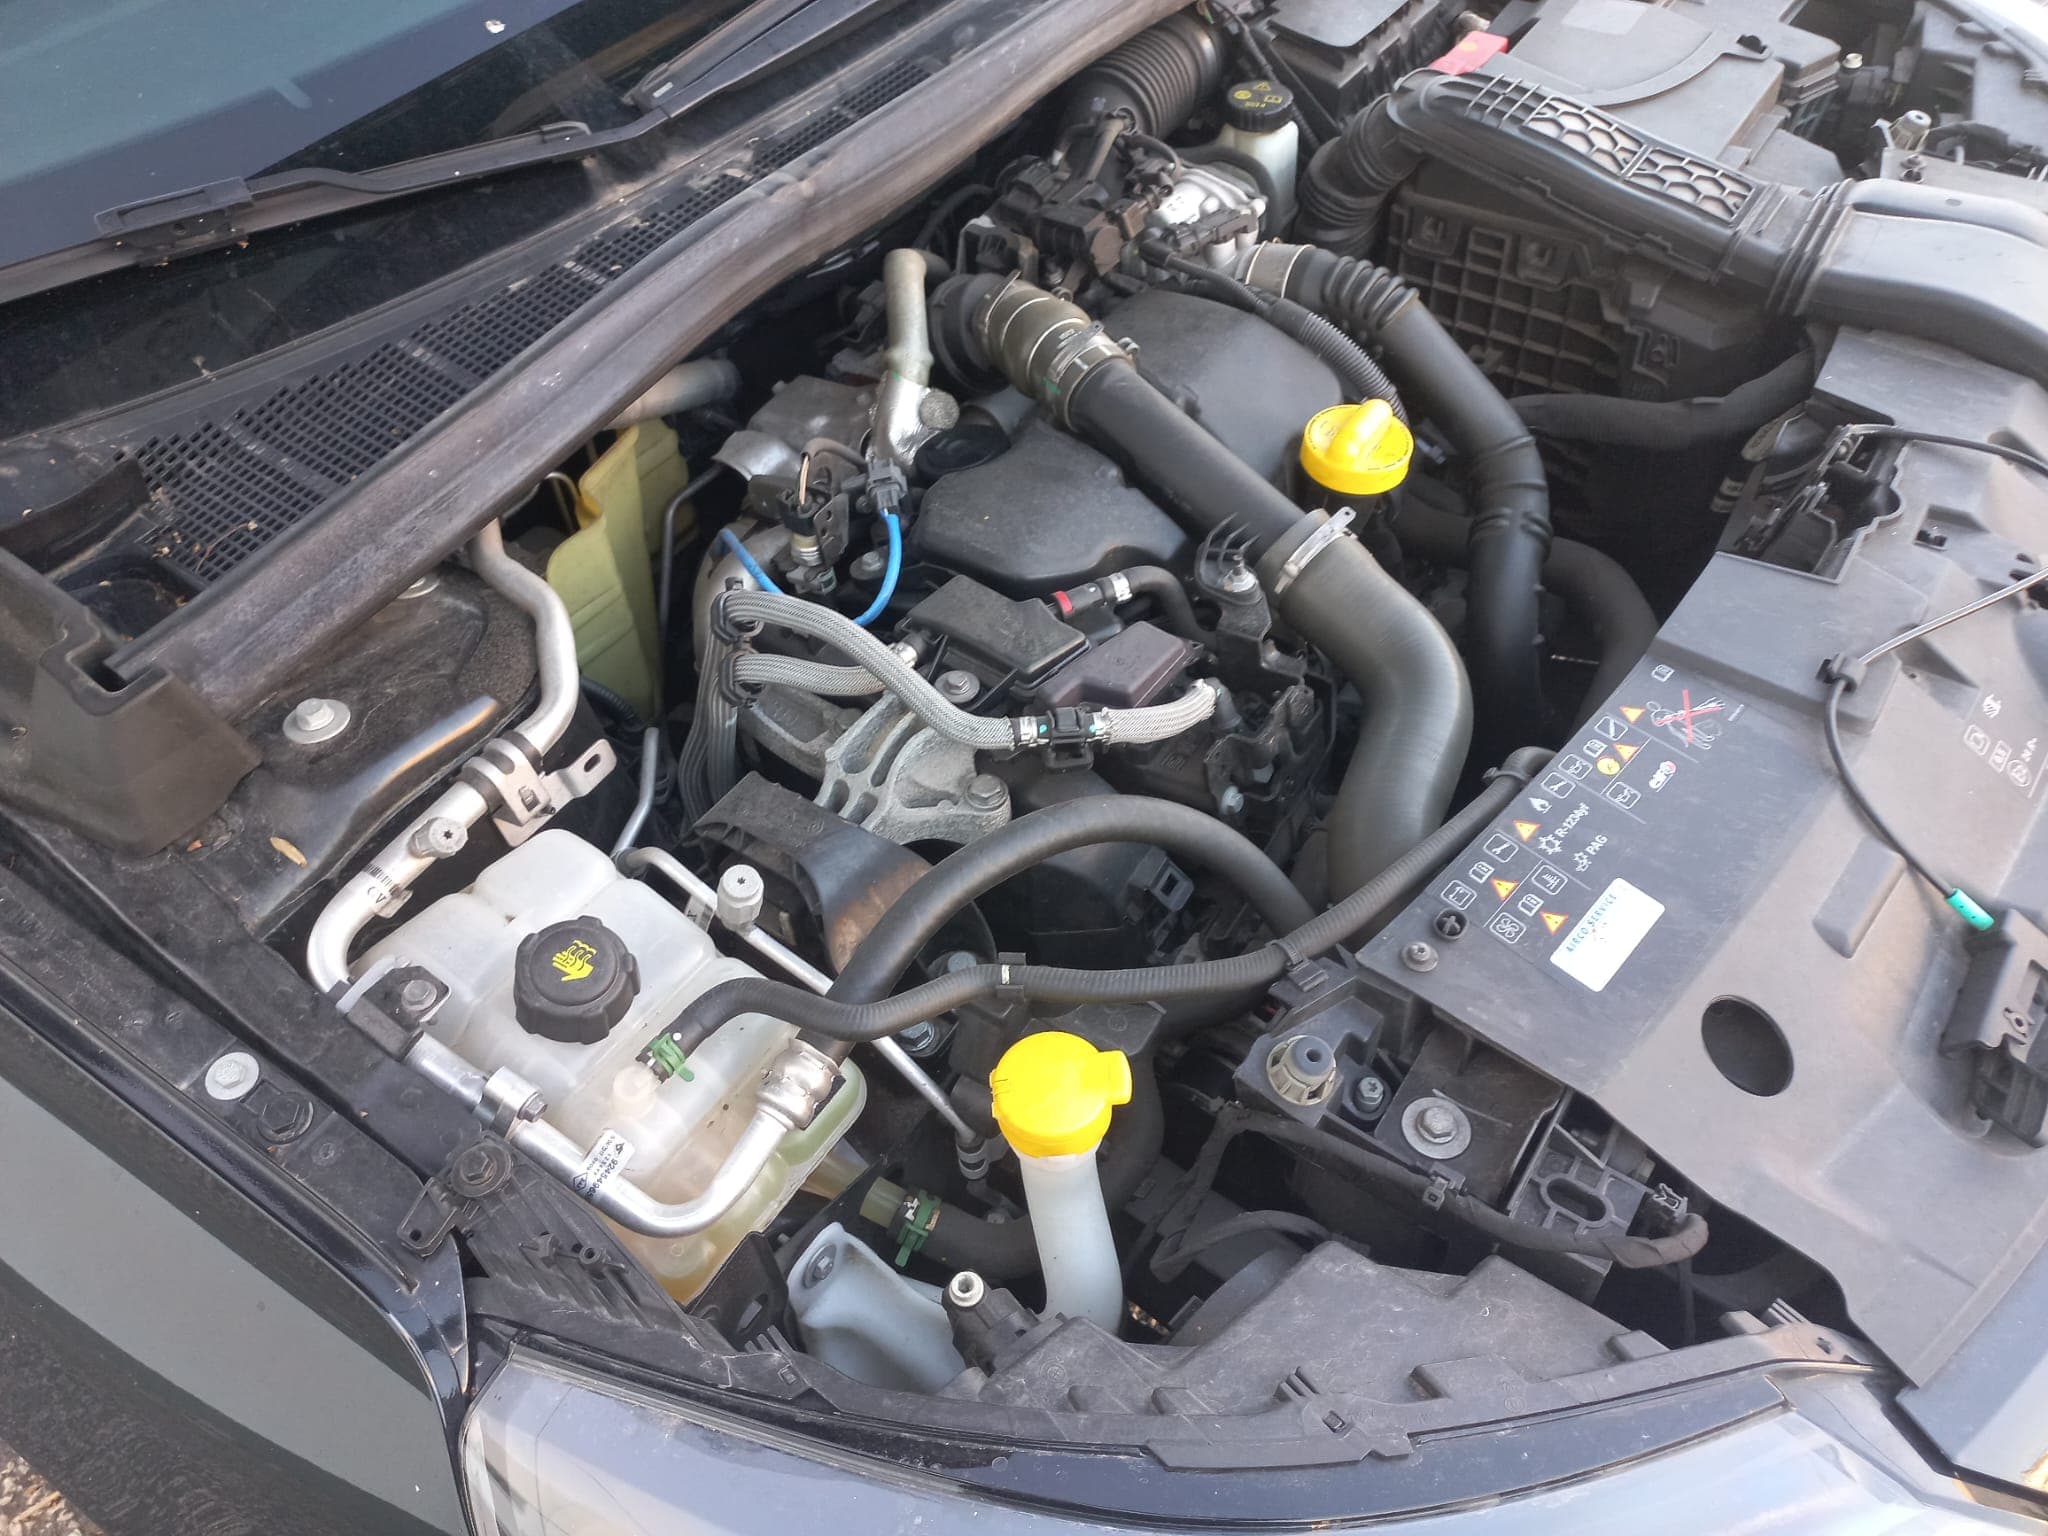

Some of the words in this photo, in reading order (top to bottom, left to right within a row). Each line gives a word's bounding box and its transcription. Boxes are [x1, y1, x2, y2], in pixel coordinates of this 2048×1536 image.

[1584, 834, 1608, 855] PAG
[1566, 927, 1590, 952] AIRCO
[1587, 893, 1617, 927] SERVICE
